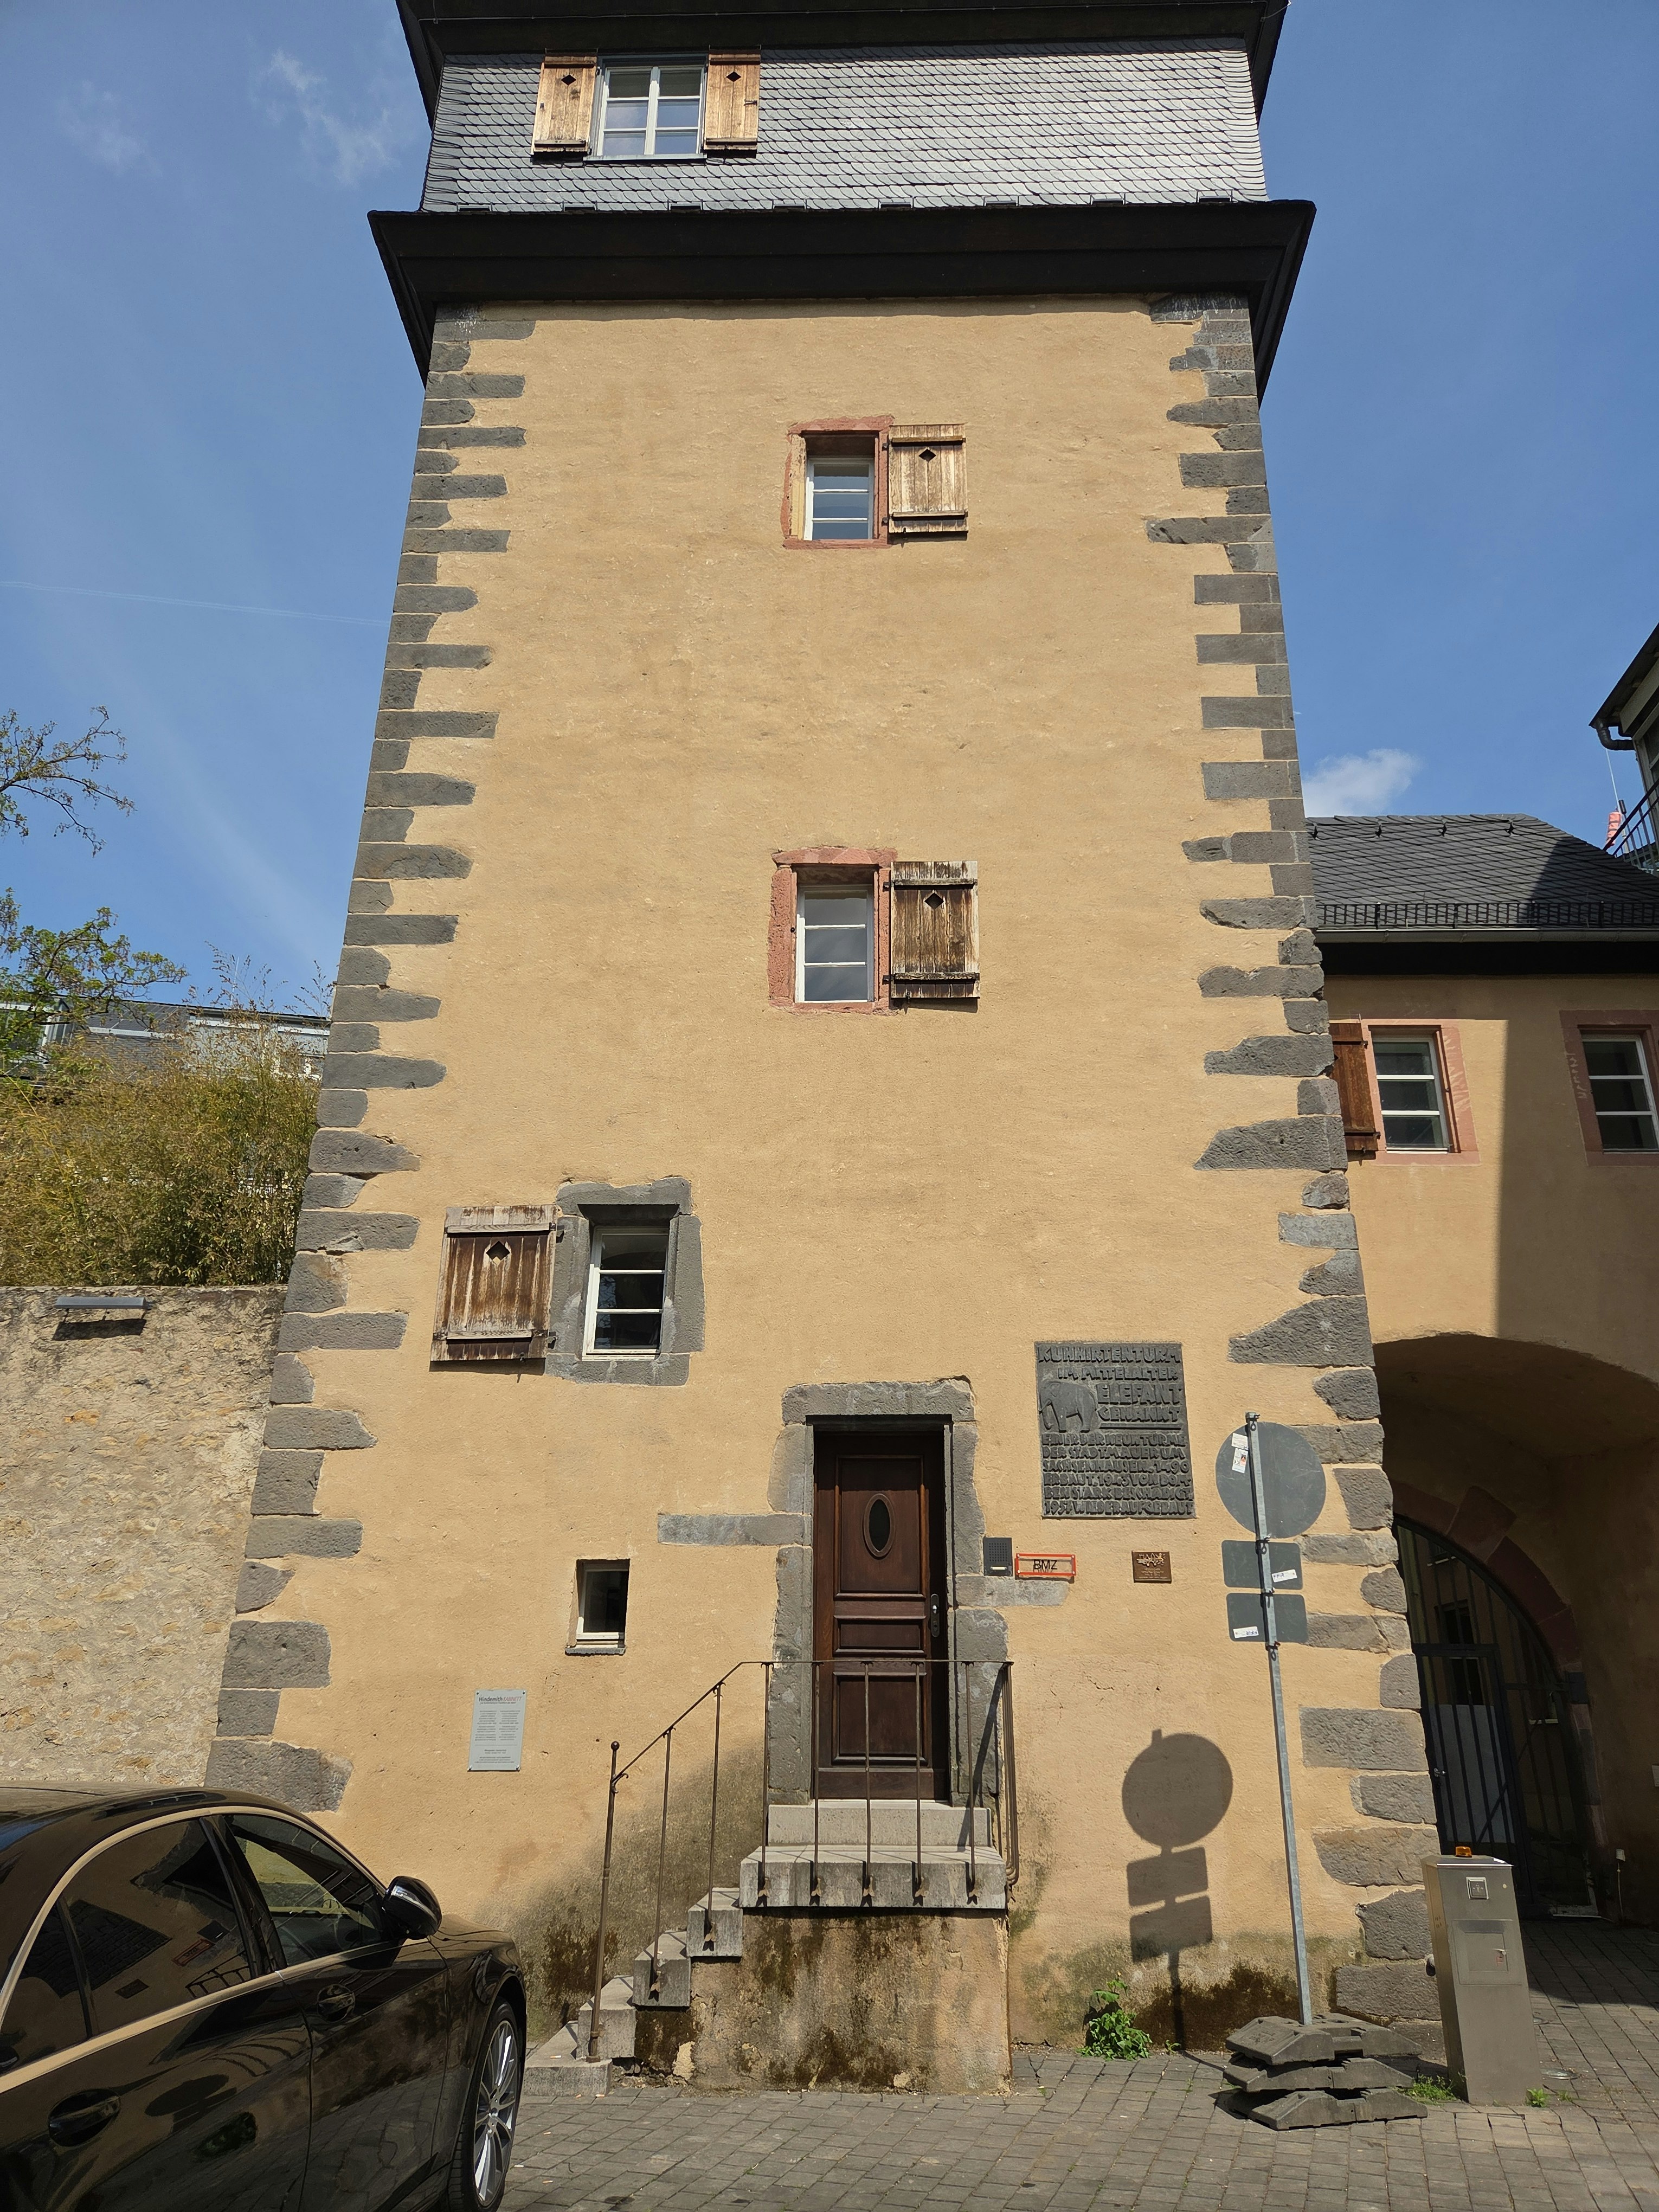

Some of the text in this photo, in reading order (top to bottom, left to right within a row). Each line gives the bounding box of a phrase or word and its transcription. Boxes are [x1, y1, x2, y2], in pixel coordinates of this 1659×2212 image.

[1038, 1347, 1181, 1364] KUHHIRTENTURM
[1058, 1366, 1180, 1381] IM MITTELALTER
[1096, 1384, 1183, 1405] ELEFANT
[1098, 1406, 1180, 1423] GENANNT
[1041, 1433, 1078, 1446] EINER
[1079, 1433, 1104, 1447] DER
[1105, 1433, 1140, 1447] NEUN
[1042, 1446, 1186, 1461] DER STADTMAUER UM
[1154, 1459, 1190, 1474] 1490
[1130, 1474, 1159, 1487] VON
[1044, 1488, 1071, 1500] BEN
[1071, 1487, 1113, 1500] STARK
[1072, 1500, 1193, 1515] WIEDERAUFGEBAUT
[1033, 1559, 1058, 1570] BMZ
